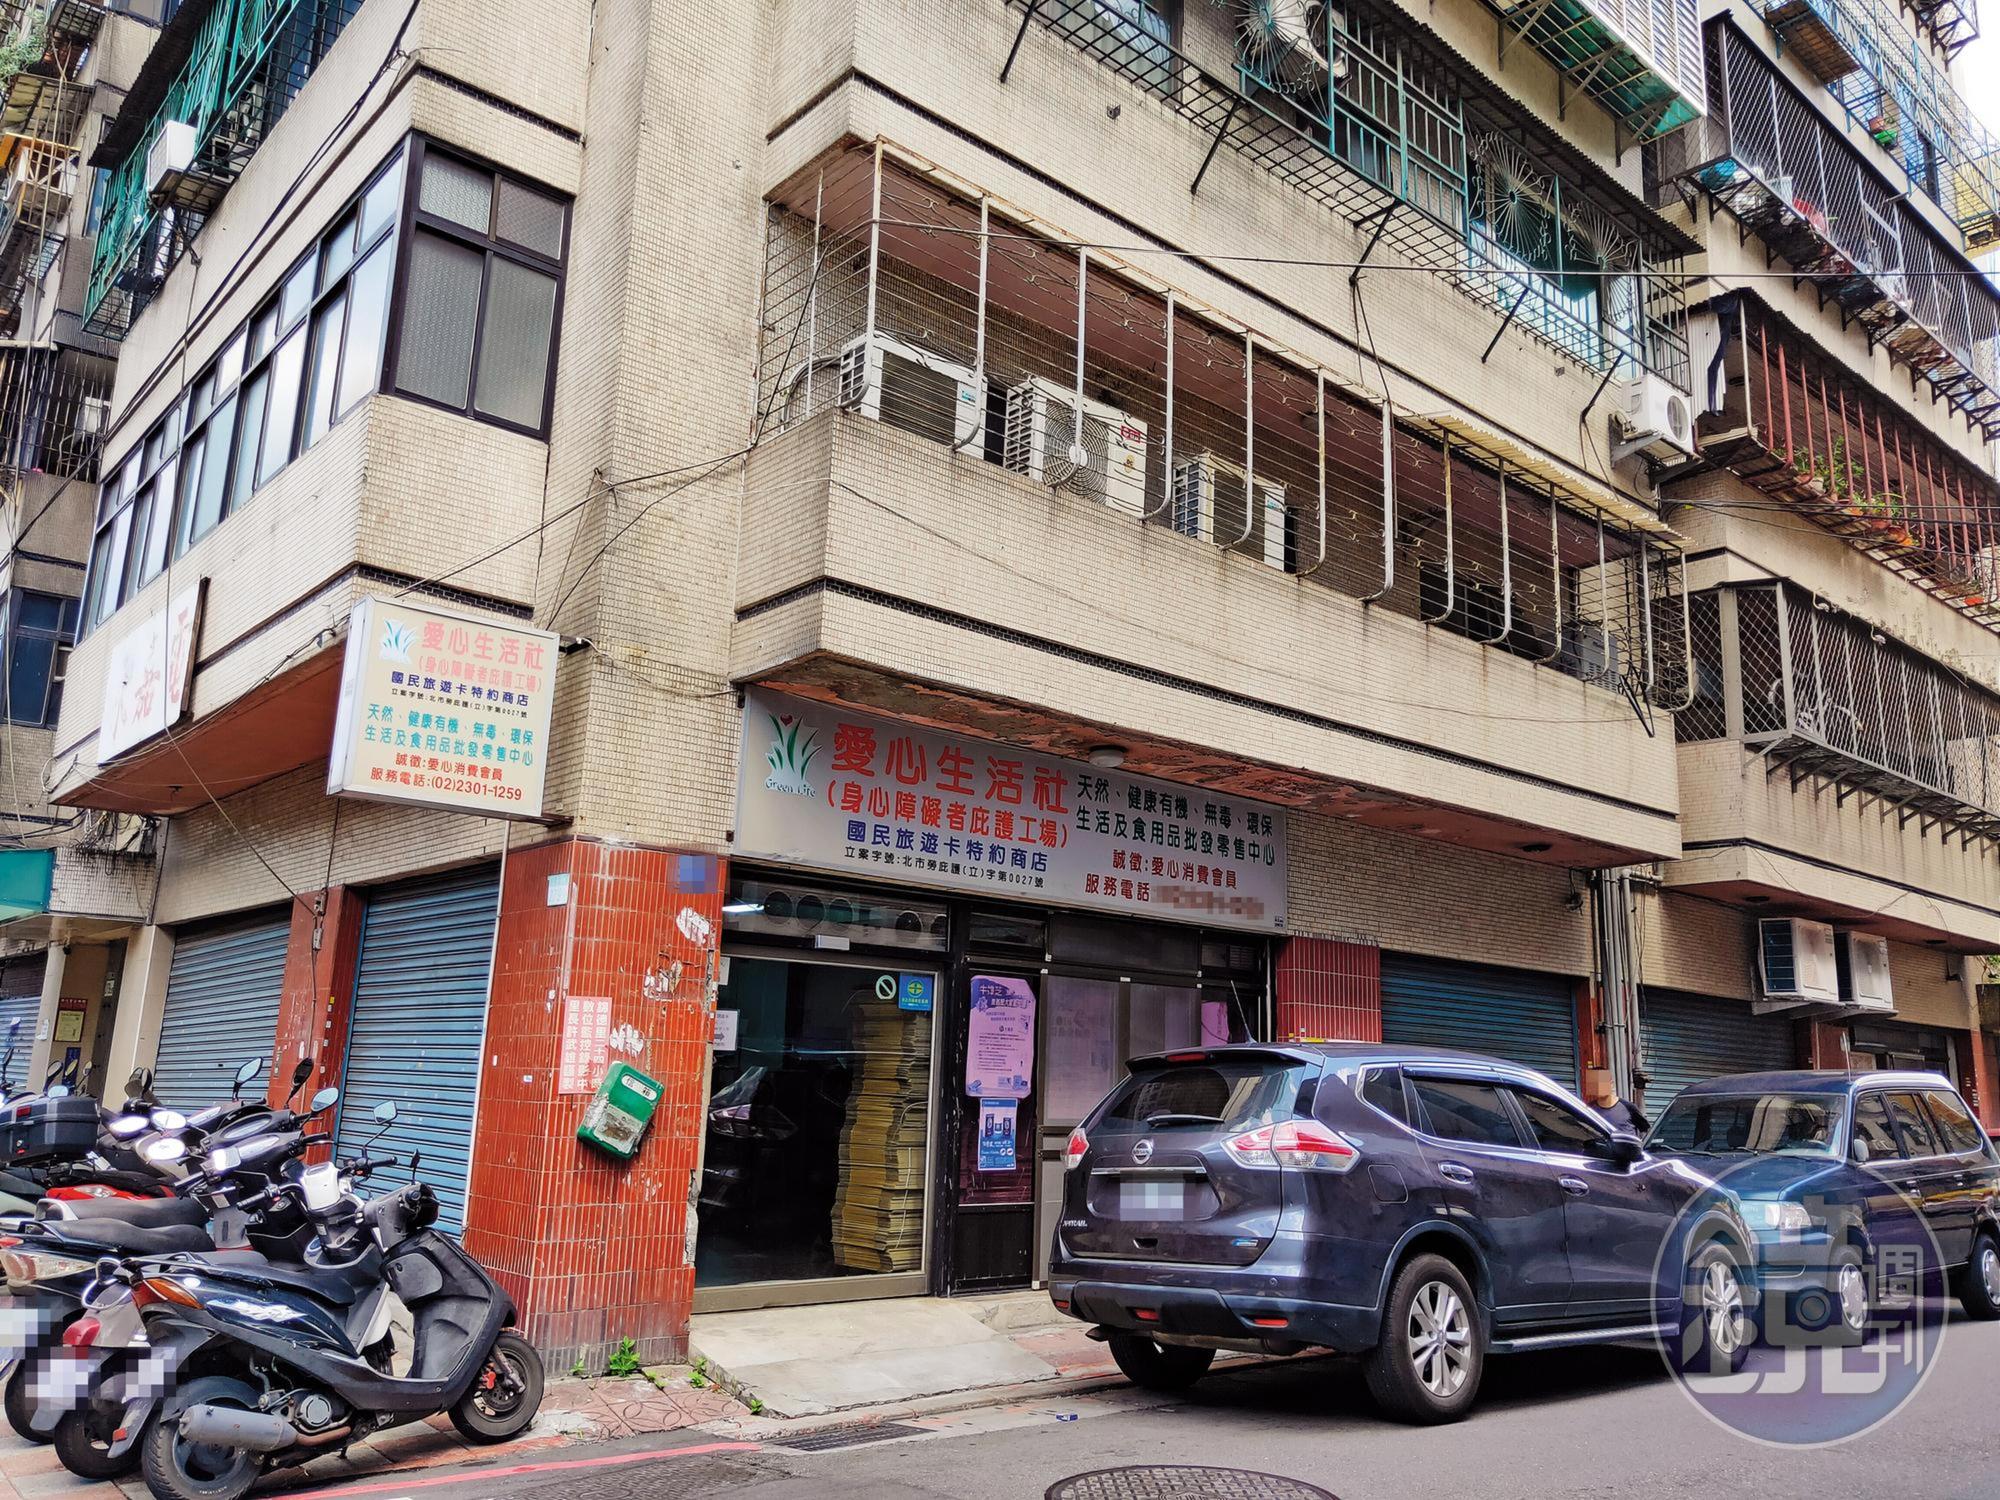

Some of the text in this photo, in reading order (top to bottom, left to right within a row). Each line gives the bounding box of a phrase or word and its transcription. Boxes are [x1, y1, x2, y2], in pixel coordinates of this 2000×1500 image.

[421, 620, 545, 671] 愛心生活社
[391, 670, 529, 707] 國民旅遊卡特約商店
[364, 724, 534, 767] 生活及食用品批發零售中心
[370, 767, 522, 801] 服務電話:(02)2301-1259
[395, 752, 503, 782] 誠徵:愛心消費會員
[766, 779, 816, 797] Green Life
[831, 722, 1069, 815] 愛心生活社
[827, 779, 1069, 849] (身心障礙者庇護工場)
[847, 819, 1048, 873] 國民旅遊卡特約商店
[1076, 805, 1275, 866] 生活及食用品批發零售中心
[844, 846, 1044, 888] 立案字號:北市勞庇護(立)字第0027號
[1085, 873, 1150, 901] 服務電話
[1112, 849, 1237, 890] 誠徵:愛心消費會員
